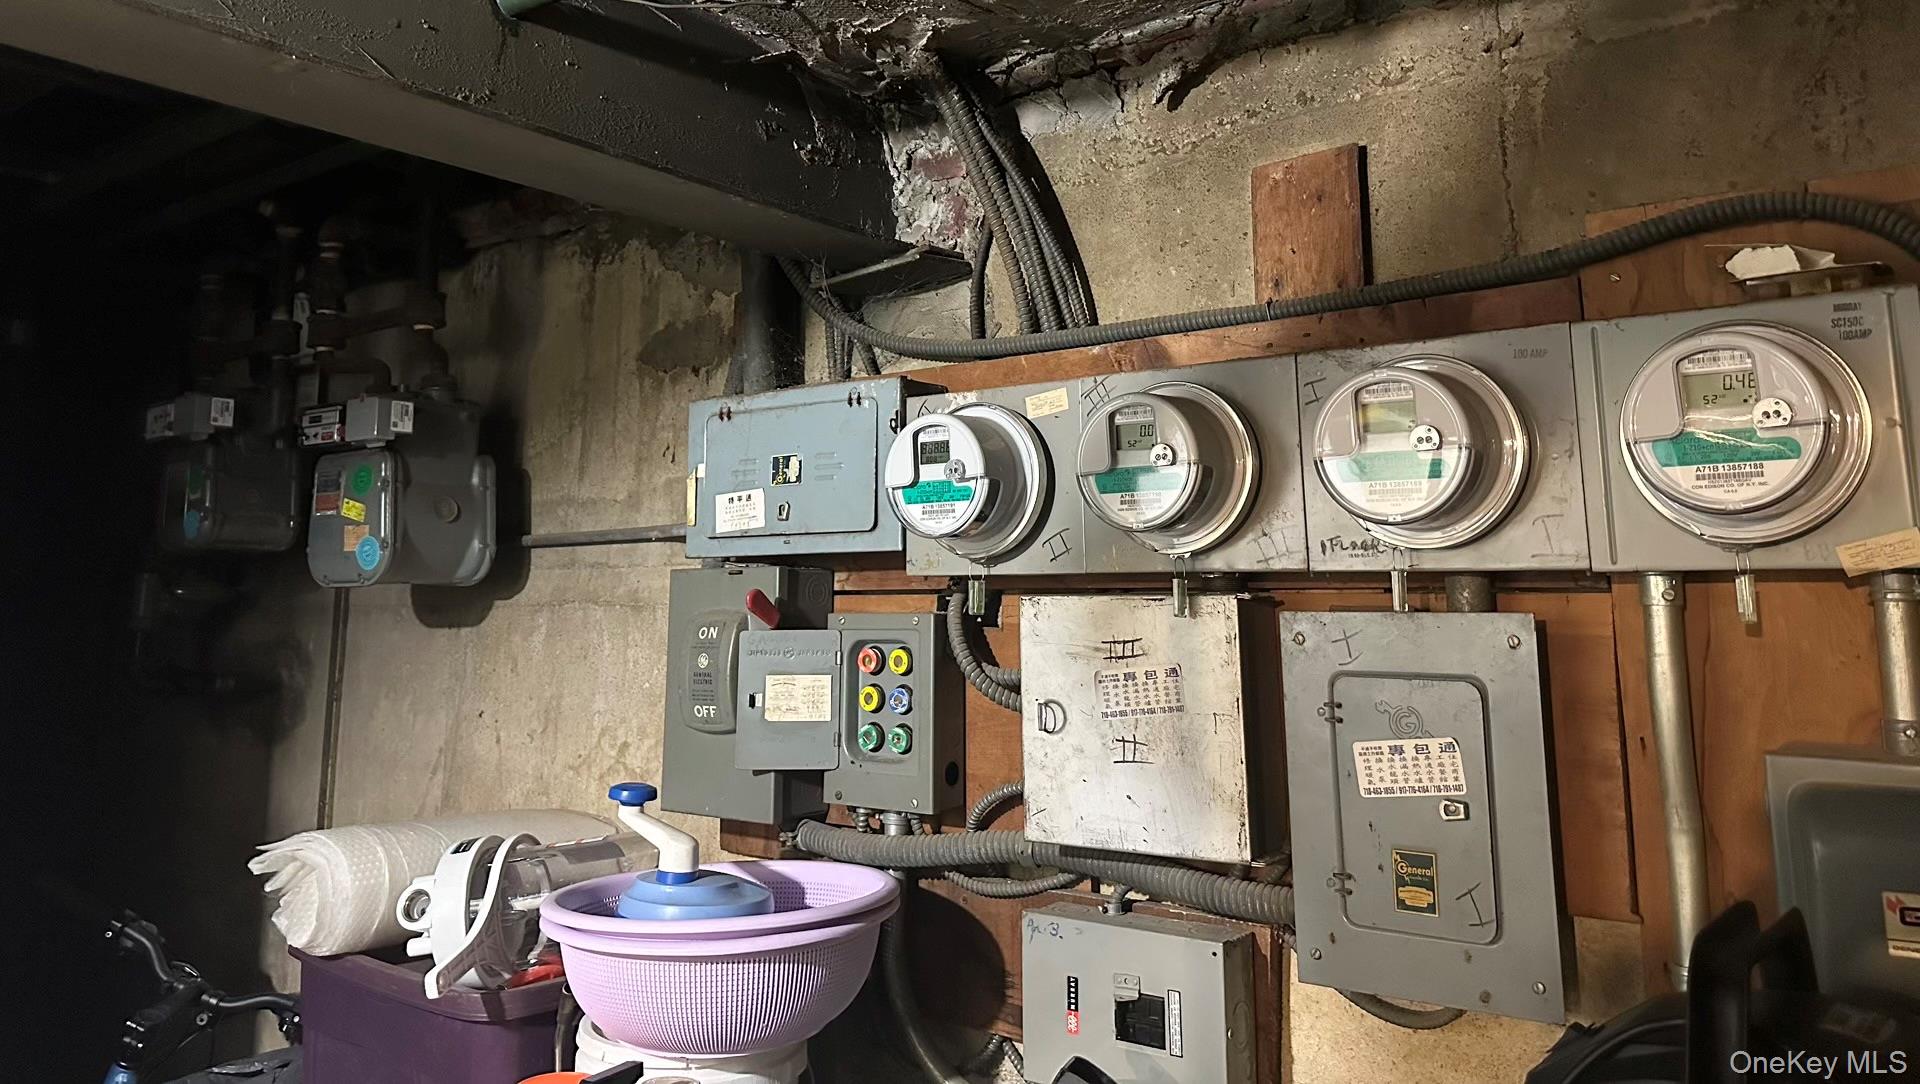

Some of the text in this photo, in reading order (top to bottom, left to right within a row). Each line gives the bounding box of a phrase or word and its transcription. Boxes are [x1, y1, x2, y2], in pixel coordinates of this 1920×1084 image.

[1513, 348, 1529, 359] 100
[1695, 462, 1764, 473] A71B 13857188
[698, 626, 719, 640] ON
[693, 705, 717, 718] OFF
[1397, 861, 1433, 877] General
